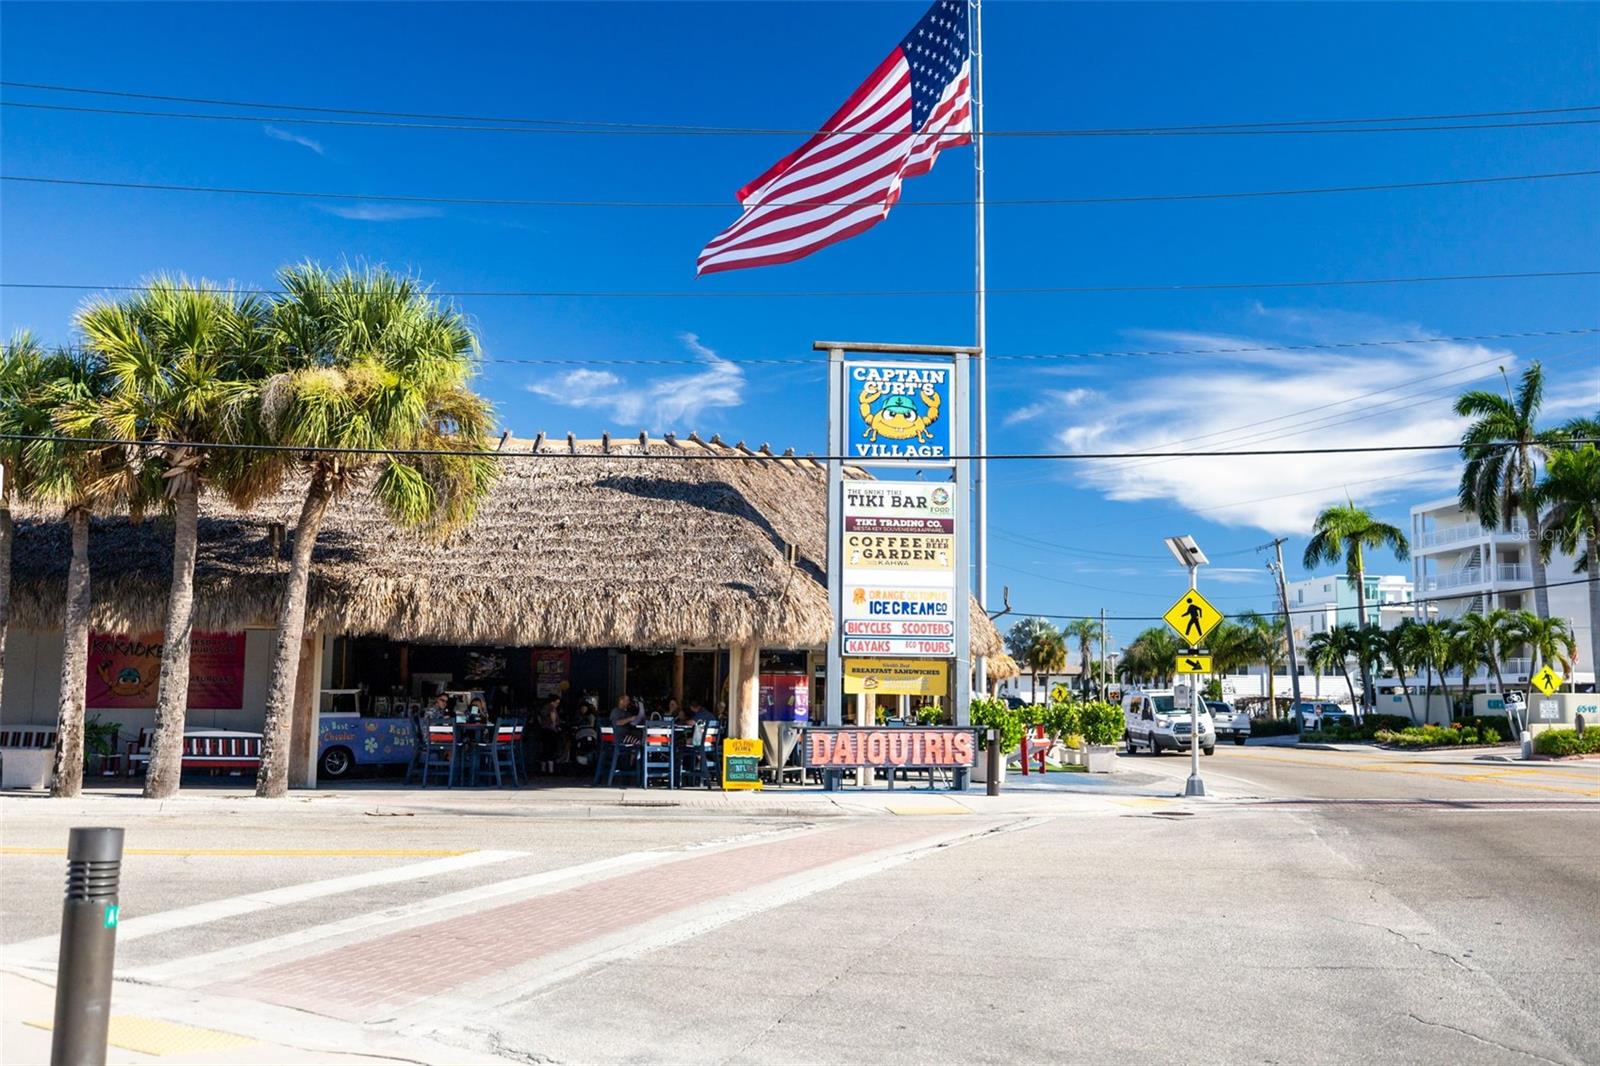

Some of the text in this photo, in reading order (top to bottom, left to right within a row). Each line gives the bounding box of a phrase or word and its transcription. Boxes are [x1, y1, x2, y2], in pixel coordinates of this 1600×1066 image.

[853, 367, 945, 384] CAPTAIN
[863, 381, 935, 396] CURT'S
[856, 443, 944, 458] VILLAGE
[847, 494, 928, 508] TIKI BAR
[849, 536, 922, 548] COFFEE
[862, 548, 936, 560] GARDEN
[869, 590, 905, 600] ORANGE
[869, 600, 890, 614] ICE
[892, 601, 934, 616] CREAM
[848, 622, 950, 634] BICYCLES SCOOTERS
[849, 640, 890, 652] KAYAKS
[918, 642, 950, 653] TOURS
[811, 731, 974, 766] DAIQUIRIS
